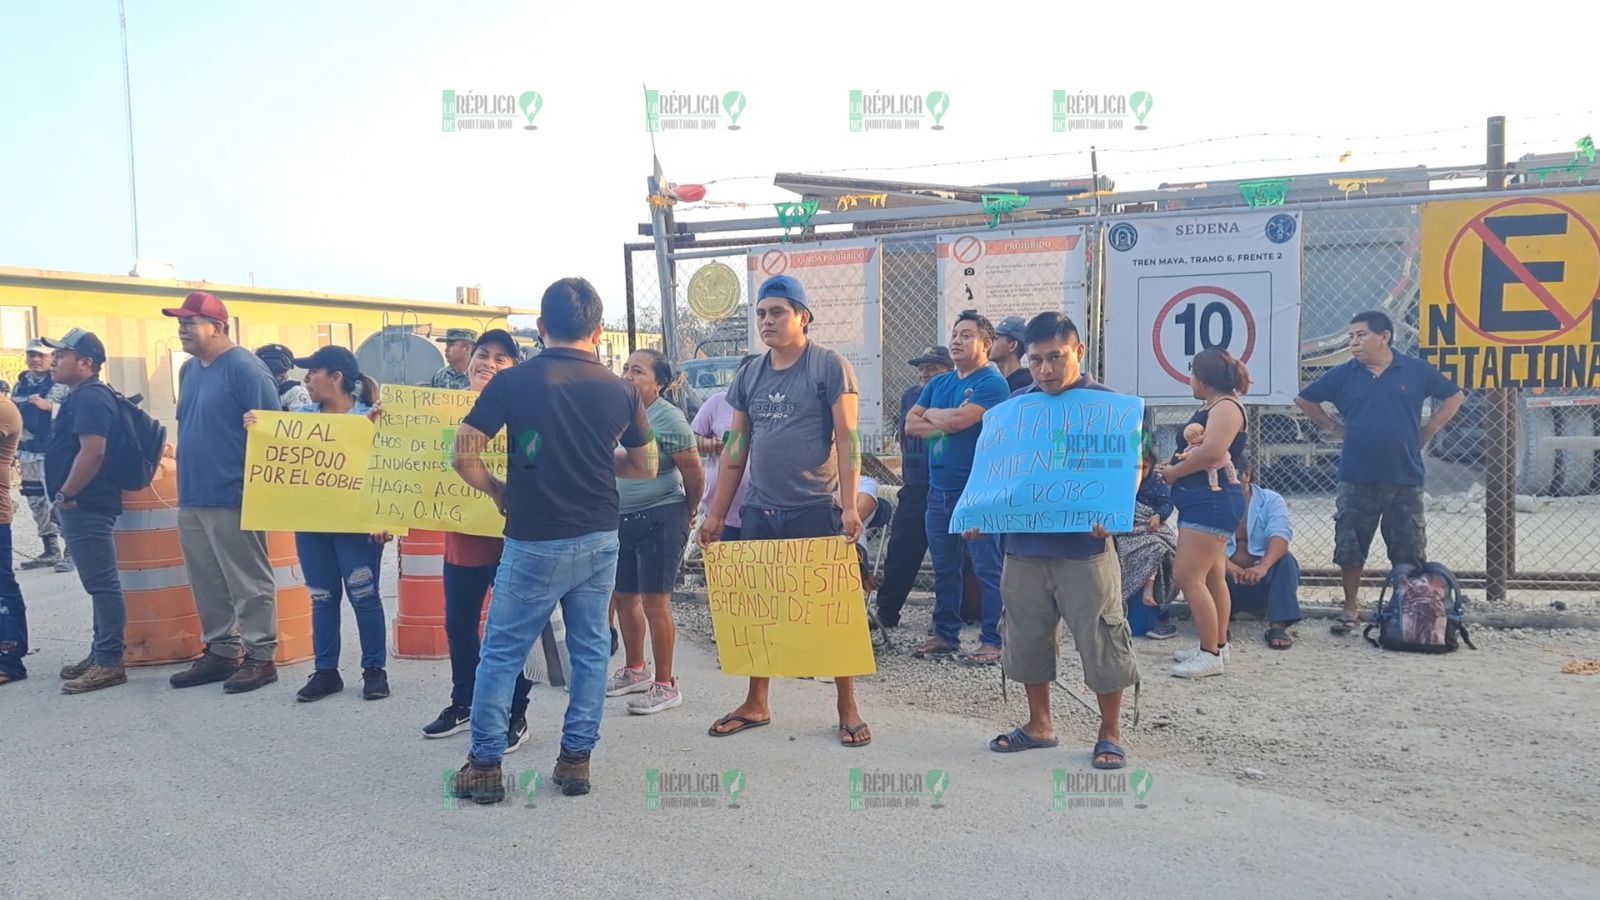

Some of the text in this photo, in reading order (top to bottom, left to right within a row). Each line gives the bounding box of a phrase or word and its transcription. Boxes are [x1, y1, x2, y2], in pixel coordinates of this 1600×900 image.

[1175, 222, 1240, 236] SEDENA
[1004, 241, 1052, 250] PROHIBIDO
[1132, 252, 1282, 267] TREN MAYA, TRAMO 6, FRENTE 2
[1479, 213, 1568, 332] E
[1175, 302, 1232, 355] 10
[412, 389, 477, 408] PRESIDE
[275, 419, 336, 442] NO AL
[373, 432, 402, 449] CHOS
[266, 446, 346, 470] DESPOJO
[368, 455, 449, 472] INDIGENAS
[250, 464, 364, 490] POR EL GOBIE
[371, 476, 422, 494] HAGAS
[992, 487, 1024, 508] AL
[1027, 480, 1105, 504] ROBO
[706, 544, 726, 564] SR
[708, 562, 860, 596] MISMO NOS ESTAS
[711, 590, 850, 626] SACANDO DE TU
